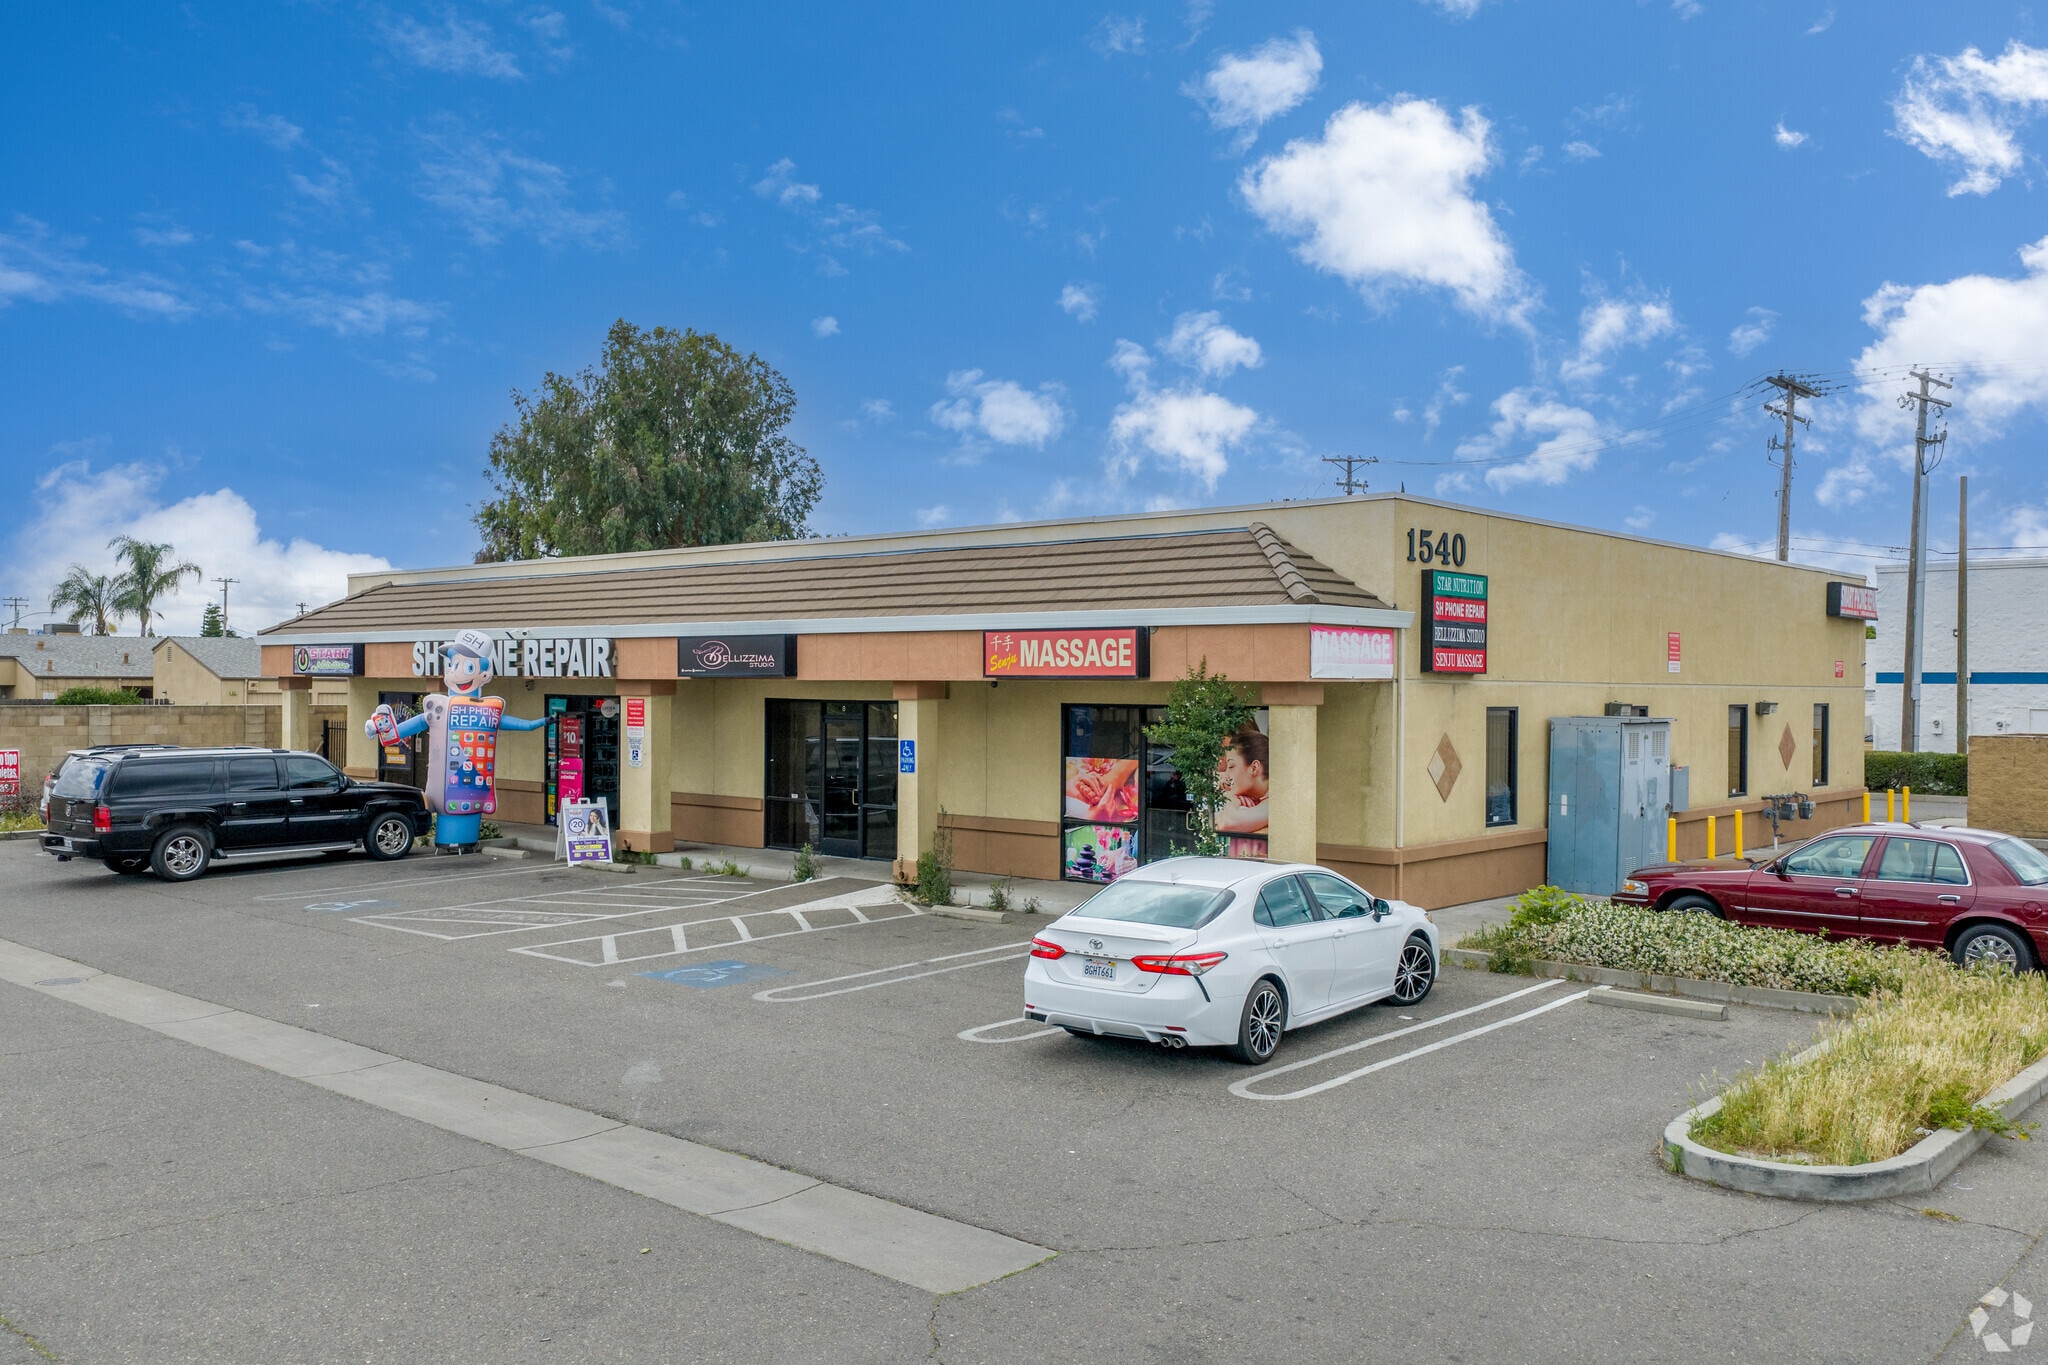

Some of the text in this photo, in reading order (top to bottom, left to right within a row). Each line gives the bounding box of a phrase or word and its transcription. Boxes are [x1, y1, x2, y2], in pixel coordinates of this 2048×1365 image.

[1407, 528, 1467, 567] 1540
[1436, 576, 1484, 595] STAR NUTRITION
[1435, 600, 1485, 619] SH PHONE REPAIR
[462, 632, 485, 650] SH
[990, 634, 1014, 652] 千手
[1434, 626, 1485, 644] BELLIZZIMA STUDIO
[310, 647, 350, 659] START
[1020, 638, 1132, 668] MASSAGE
[1312, 630, 1391, 660] MASSAGE
[412, 641, 439, 677] SH
[523, 638, 611, 677] REPAIR
[990, 652, 1017, 671] Senju
[1435, 651, 1484, 668] SENJU MASSAGE
[451, 705, 500, 718] SH PHONE
[450, 714, 499, 729] REPAIR
[563, 731, 577, 744] $10
[4, 752, 18, 766] tipo
[1084, 965, 1113, 978] 8GHT661
